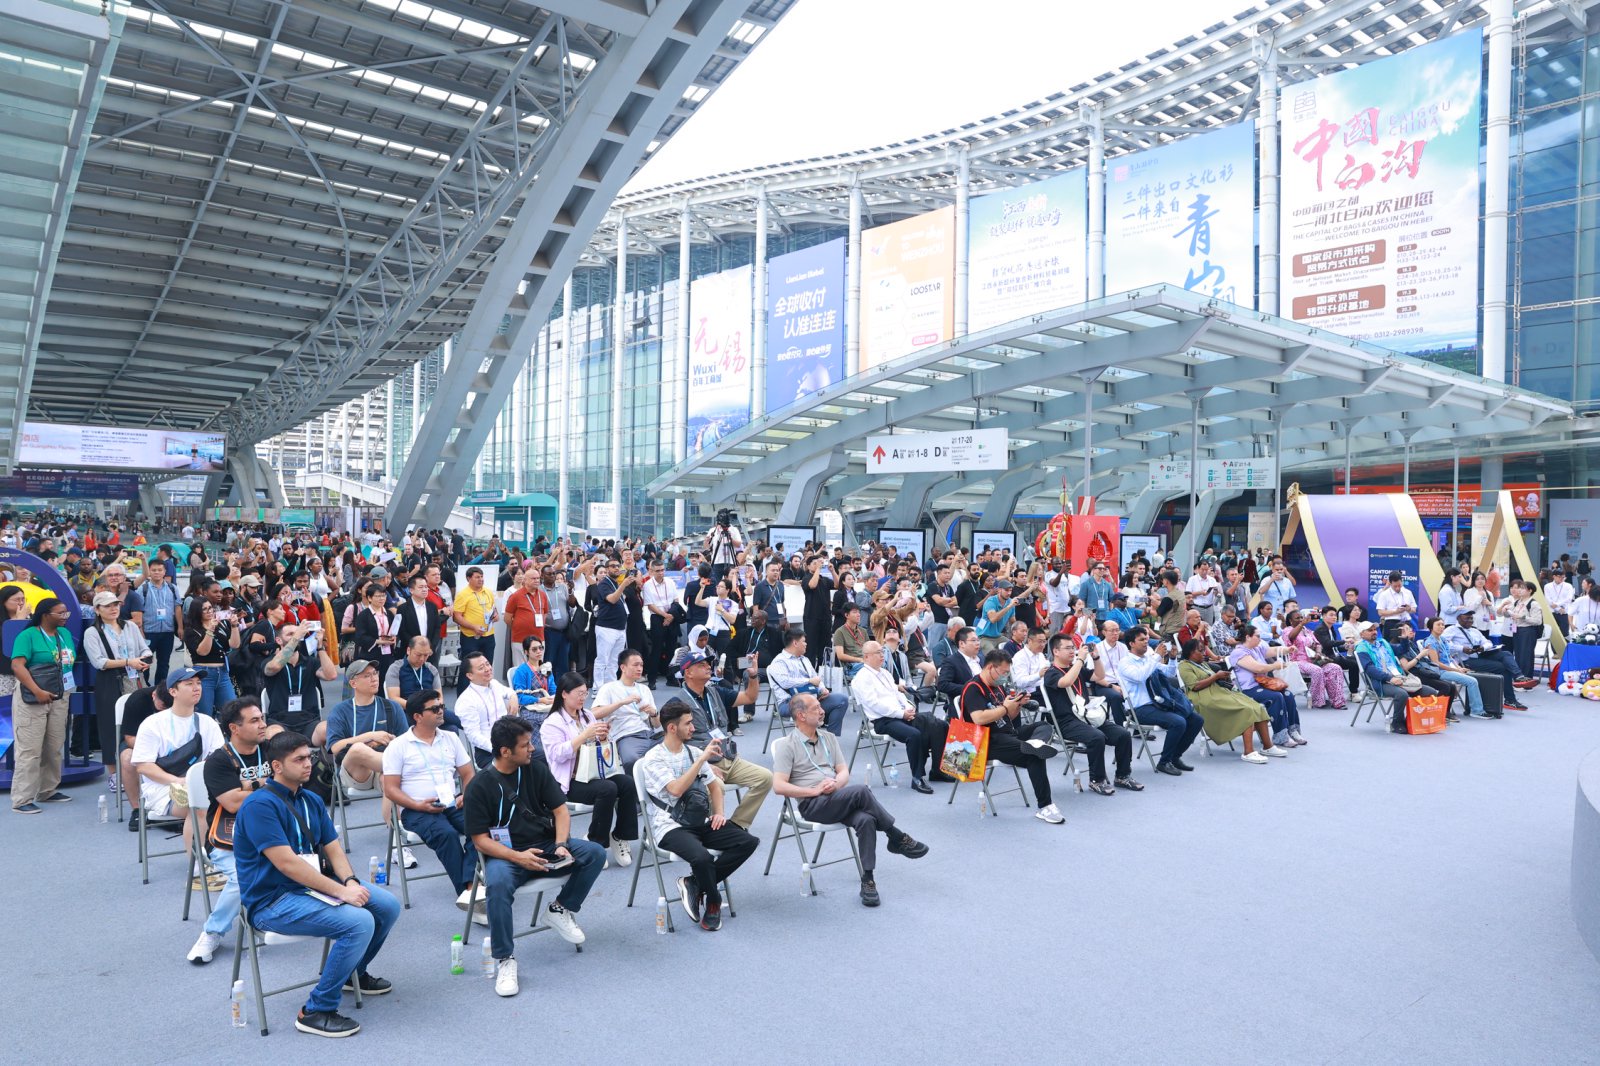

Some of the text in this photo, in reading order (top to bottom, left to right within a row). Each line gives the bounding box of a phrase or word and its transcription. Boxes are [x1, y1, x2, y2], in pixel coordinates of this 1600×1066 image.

[1389, 116, 1439, 136] CHINA
[1123, 163, 1233, 205] 三件出口文化衫
[1122, 196, 1181, 220] 一件来自
[1292, 195, 1360, 217] 中国箱包之都
[1305, 228, 1332, 238] CAPITAL
[1343, 223, 1361, 231] BAGS
[1367, 217, 1389, 227] CASES
[1390, 215, 1399, 223] IN
[1399, 210, 1425, 221] CHINA
[1371, 221, 1400, 233] BAIGOU
[1400, 220, 1409, 228] IN
[1302, 243, 1376, 264] 国家级市场采购
[774, 286, 827, 318] 全球收付
[783, 309, 837, 339] 认准连连
[694, 316, 746, 375] 无锡
[692, 361, 717, 376] Wuxi
[958, 436, 973, 444] 17-20
[892, 448, 899, 459] A
[915, 448, 928, 458] 1-8
[934, 446, 942, 457] D
